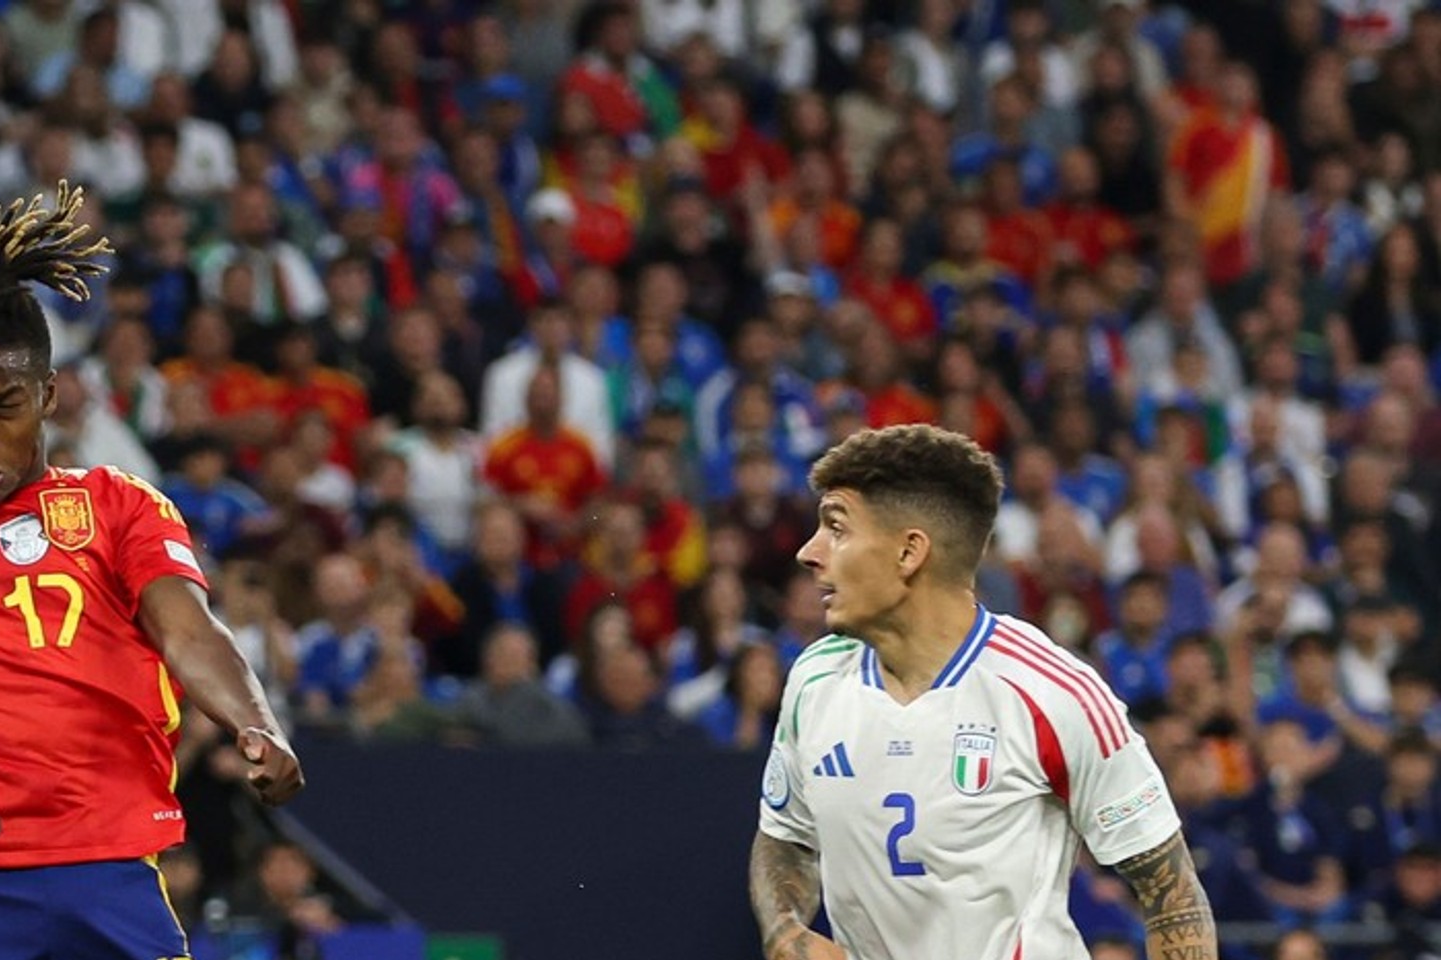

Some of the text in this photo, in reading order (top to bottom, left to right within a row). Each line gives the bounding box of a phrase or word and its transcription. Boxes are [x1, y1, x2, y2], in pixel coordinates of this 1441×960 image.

[2, 572, 85, 650] 17
[958, 736, 993, 751] ITALIA
[881, 792, 928, 877] 2
